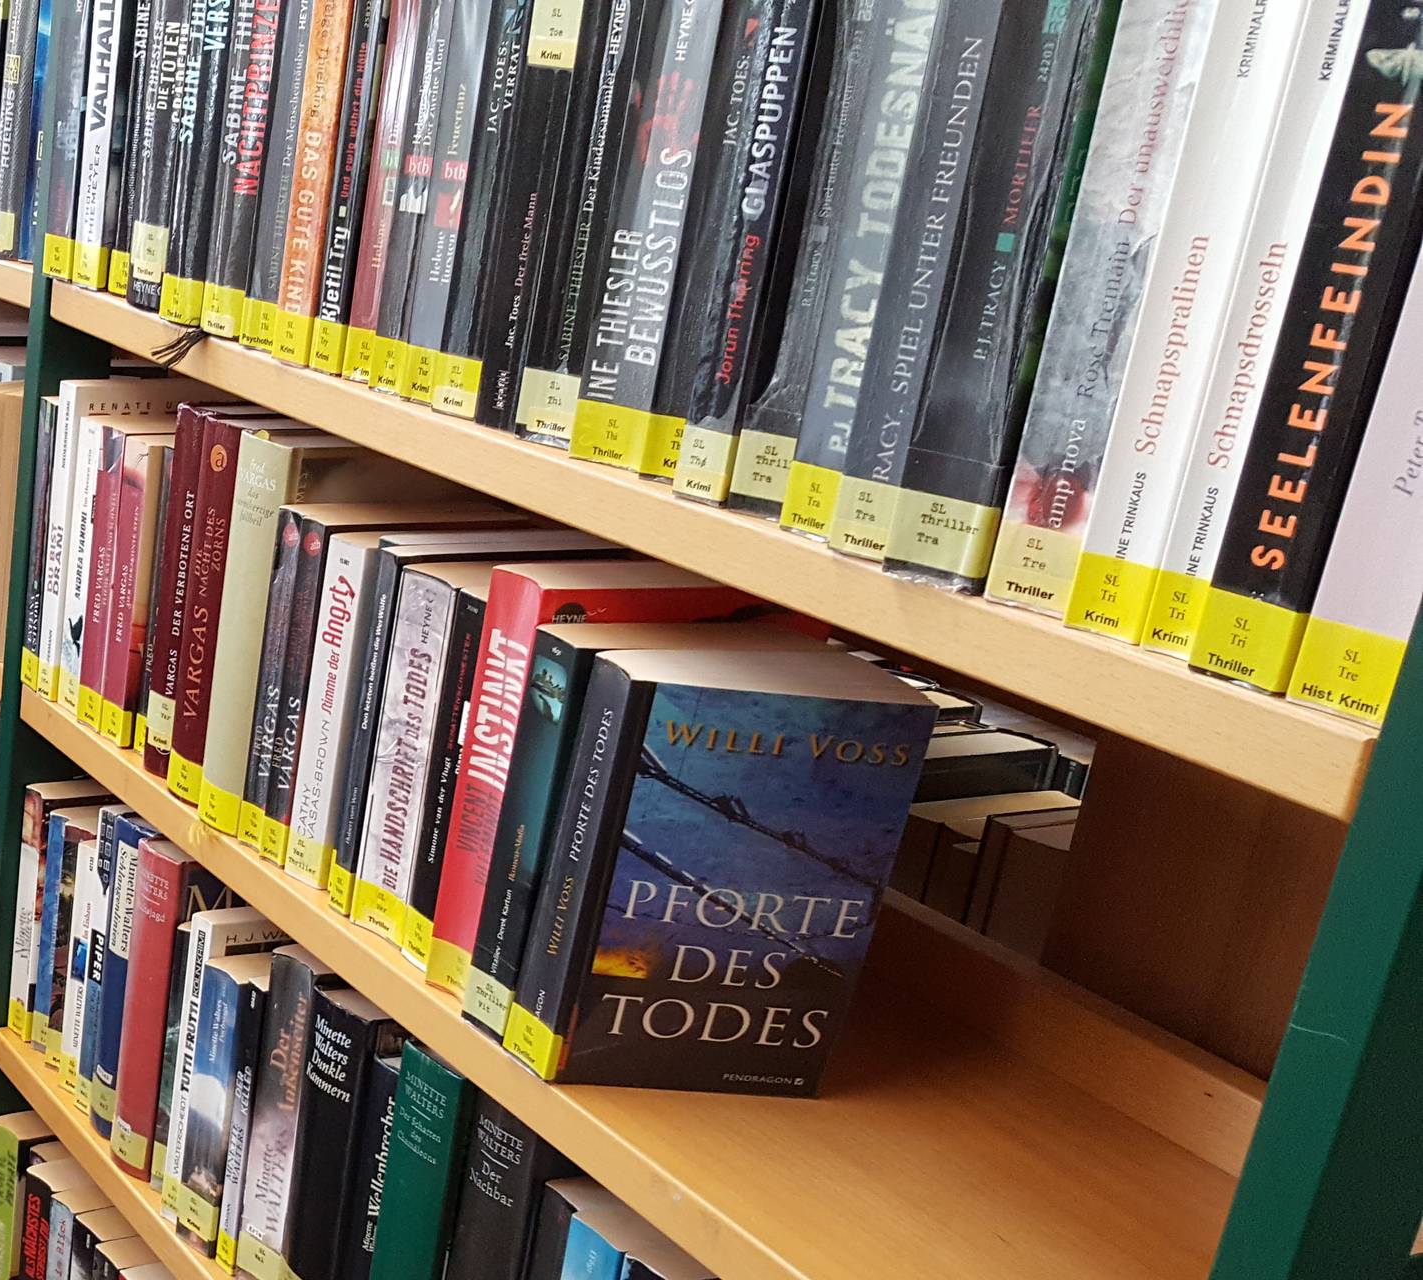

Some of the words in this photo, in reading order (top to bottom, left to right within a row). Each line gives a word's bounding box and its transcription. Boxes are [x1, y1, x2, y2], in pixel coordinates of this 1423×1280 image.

[133, 0, 151, 59] SABINE
[609, 2, 626, 55] HEYNE
[160, 22, 181, 85] TOTEN
[493, 41, 510, 93] TOES:
[540, 51, 562, 61] Krimi
[503, 42, 521, 111] VERRAT
[730, 54, 751, 104] TOES:
[156, 86, 169, 110] DIE
[179, 54, 202, 143] SABINE
[223, 68, 247, 165] SABINE
[487, 98, 502, 134] JAC.
[447, 83, 467, 156] Feuertanz
[723, 107, 741, 147] JAC.
[301, 131, 323, 181] DAS
[409, 160, 430, 175] btb
[444, 164, 467, 179] btb
[1003, 105, 1042, 226] MORTIFER
[583, 188, 597, 213] Der
[624, 147, 693, 367] BEWUSSTLOS
[675, 8, 694, 62] HEYNE
[715, 328, 740, 385] Jorun
[742, 25, 799, 219] GLASPUPPEN
[292, 189, 315, 250] GUTE
[523, 192, 538, 229] Mann
[891, 322, 925, 394] SPIEL
[908, 212, 947, 314] UNTER
[932, 36, 983, 204] FREUNDEN
[331, 225, 351, 263] Try
[565, 221, 592, 302] THIESLER
[285, 257, 307, 313] KIND
[321, 264, 344, 322] Kjetil
[597, 229, 644, 352] THIESLER
[559, 304, 578, 360] SABINE
[823, 258, 886, 408] TRACY
[1060, 418, 1086, 473] nova
[1077, 349, 1103, 398] Rose
[1091, 241, 1130, 336] Tremain
[1118, 185, 1143, 225] Der
[1250, 102, 1414, 572] SEELENFEINDIN
[377, 376, 396, 387] Krimi
[411, 382, 429, 393] Krimi
[1122, 471, 1147, 535] TRINKAUS
[1135, 234, 1210, 456] Schnapspralinen
[1192, 487, 1219, 555] TRINKAUS
[1208, 240, 1288, 469] Schnapsdrosseln
[88, 401, 151, 412] RENATE
[443, 397, 463, 408] Krimi
[535, 419, 566, 433] Thriller
[592, 446, 623, 460] Thriller
[686, 480, 711, 492] Krimi
[752, 472, 772, 483] Tra
[183, 490, 195, 521] ORT
[206, 506, 216, 535] DES
[791, 513, 825, 530] Thriller
[855, 509, 875, 522] Tra
[920, 513, 979, 535] Thriller
[211, 517, 226, 571] ZORNS
[843, 533, 885, 551] Thriller
[916, 532, 939, 545] Tra
[174, 524, 191, 610] VERBOTENE
[1023, 557, 1046, 571] Tre
[1006, 580, 1054, 601] Thriller
[1100, 588, 1117, 603] Tri
[171, 611, 182, 637] DER
[420, 604, 433, 645] HEYNE
[551, 613, 587, 625] HEYNE
[1084, 609, 1120, 628] Krimi
[1169, 606, 1186, 621] Tri
[1152, 627, 1189, 647] Krimi
[1230, 633, 1247, 648] Tri
[165, 649, 178, 697] VARGAS
[183, 605, 210, 719] VARGAS
[327, 649, 341, 671] der
[403, 647, 432, 710] TODES
[1208, 652, 1255, 678] Thriller
[1337, 665, 1358, 682] Tre
[467, 627, 528, 794] INSTINKT
[1339, 692, 1380, 717] Krimi
[258, 685, 281, 778] VARGAS
[278, 696, 302, 791] VARGAS
[405, 712, 422, 740] DES
[592, 707, 614, 764] TODES
[663, 718, 785, 757] WILLI
[806, 732, 911, 769] VOSS
[305, 719, 331, 841] VASAS-BROWN
[584, 767, 601, 799] DES
[297, 783, 311, 837] CATHY
[379, 737, 418, 866] HANDSCHRIFT
[428, 829, 438, 864] Simone
[441, 756, 452, 789] Vlugt
[456, 782, 485, 853] VINCENT
[568, 800, 591, 863] PFORTE
[125, 854, 138, 906] Minette
[382, 868, 398, 891] DIE
[556, 874, 575, 912] VOSS
[121, 907, 134, 952] Walters
[622, 879, 864, 940] PFORTE
[545, 912, 565, 956] WILLI
[92, 933, 106, 983] PIPER
[667, 944, 787, 990] DES
[185, 1002, 199, 1051] FRUTTI
[314, 1013, 352, 1050] Minette
[601, 993, 830, 1051] TODES
[311, 1051, 346, 1083] Dunkle
[314, 1031, 349, 1066] Walters
[180, 1054, 194, 1094] TUTTI
[305, 1061, 352, 1104] Kammern
[405, 1071, 447, 1107] MINETTE
[723, 1072, 793, 1086] PENDRAGON
[404, 1084, 444, 1120] WALTERS
[477, 1127, 521, 1165] WALTERS
[479, 1114, 524, 1151] MINETTE
[367, 1096, 397, 1217] Wellenbrecher
[481, 1161, 502, 1184] Der
[469, 1167, 514, 1208] Nachbar
